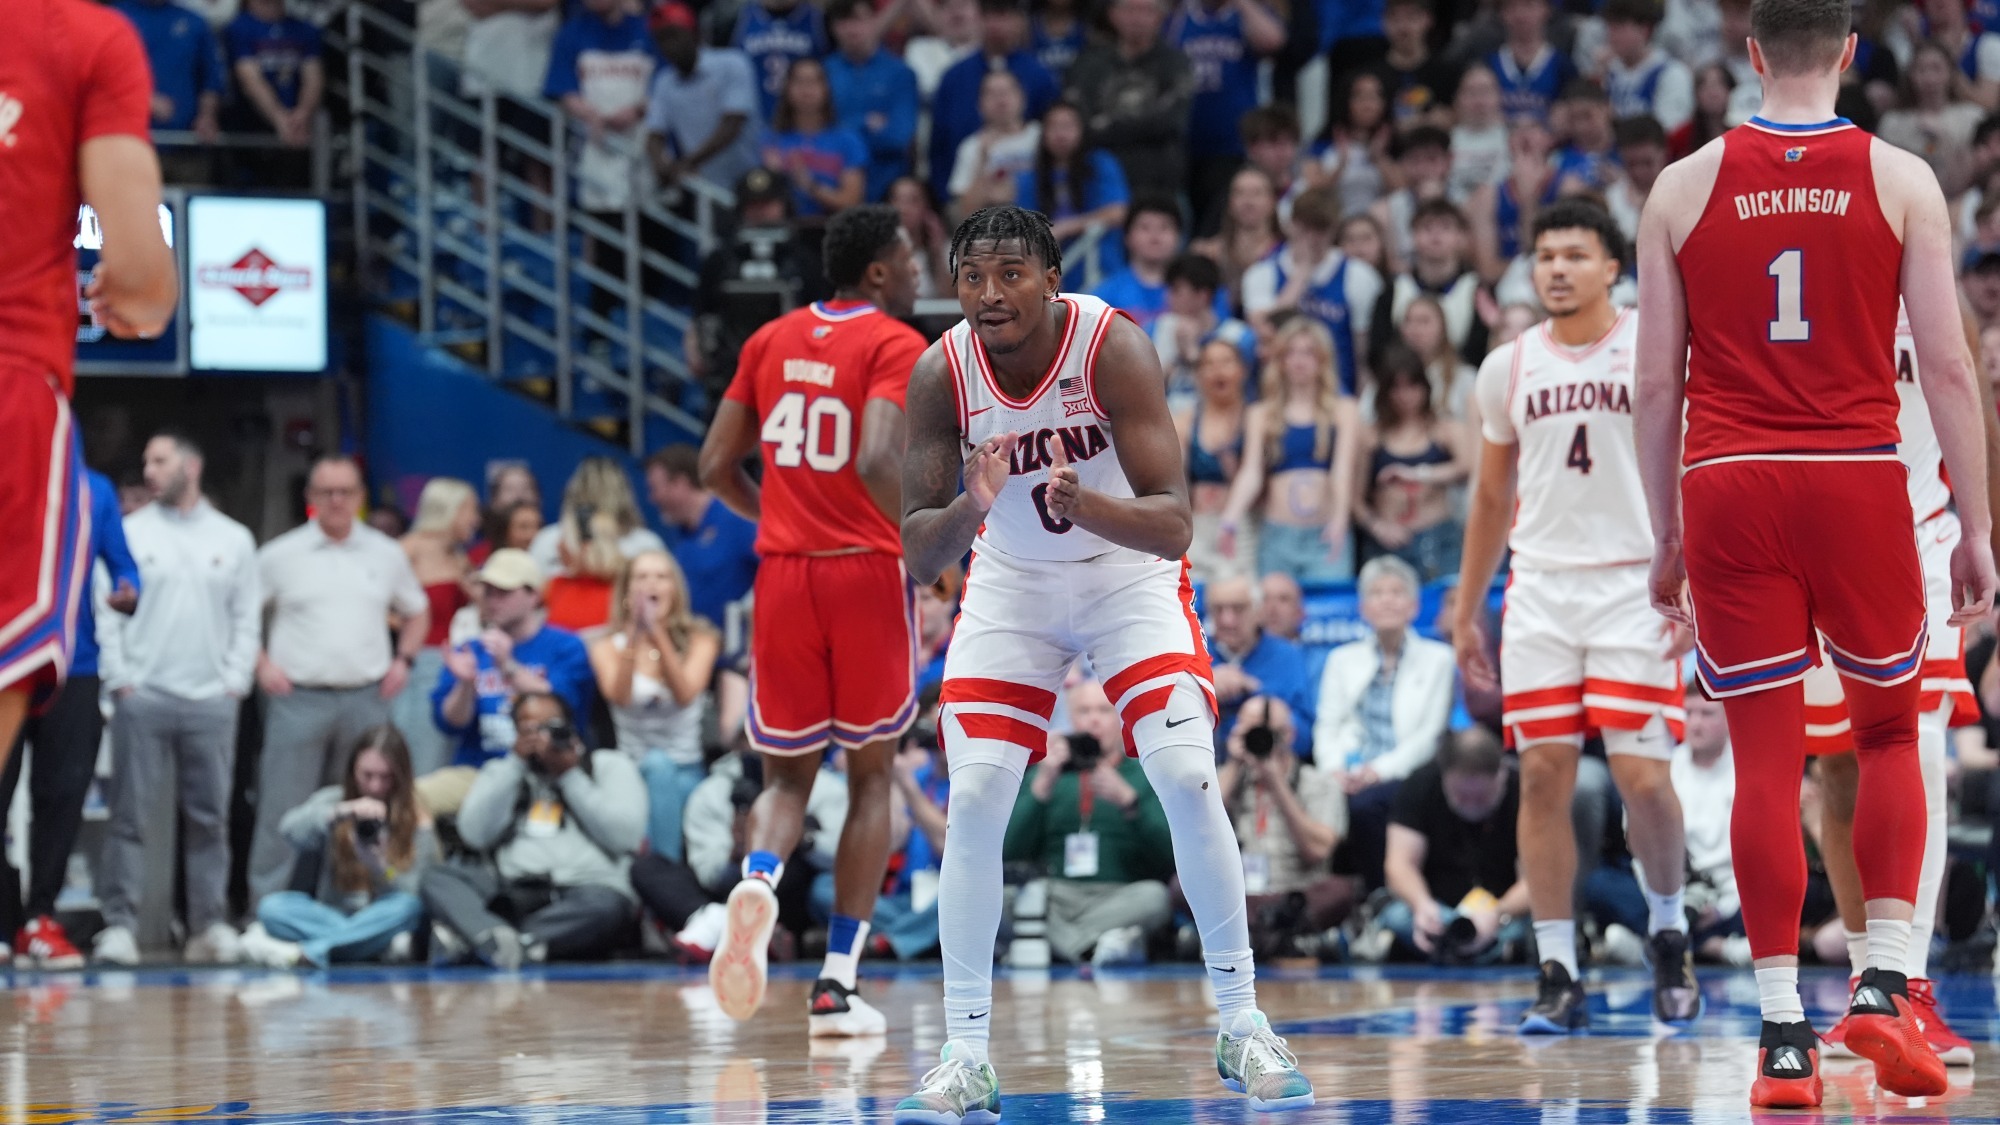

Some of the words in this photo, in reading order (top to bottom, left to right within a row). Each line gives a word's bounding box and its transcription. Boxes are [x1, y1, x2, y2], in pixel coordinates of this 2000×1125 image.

[1733, 188, 1851, 221] DICKINSON
[1767, 248, 1810, 342] 1
[1525, 381, 1632, 426] ARIZONA
[761, 391, 852, 473] 40
[1566, 422, 1593, 475] 4
